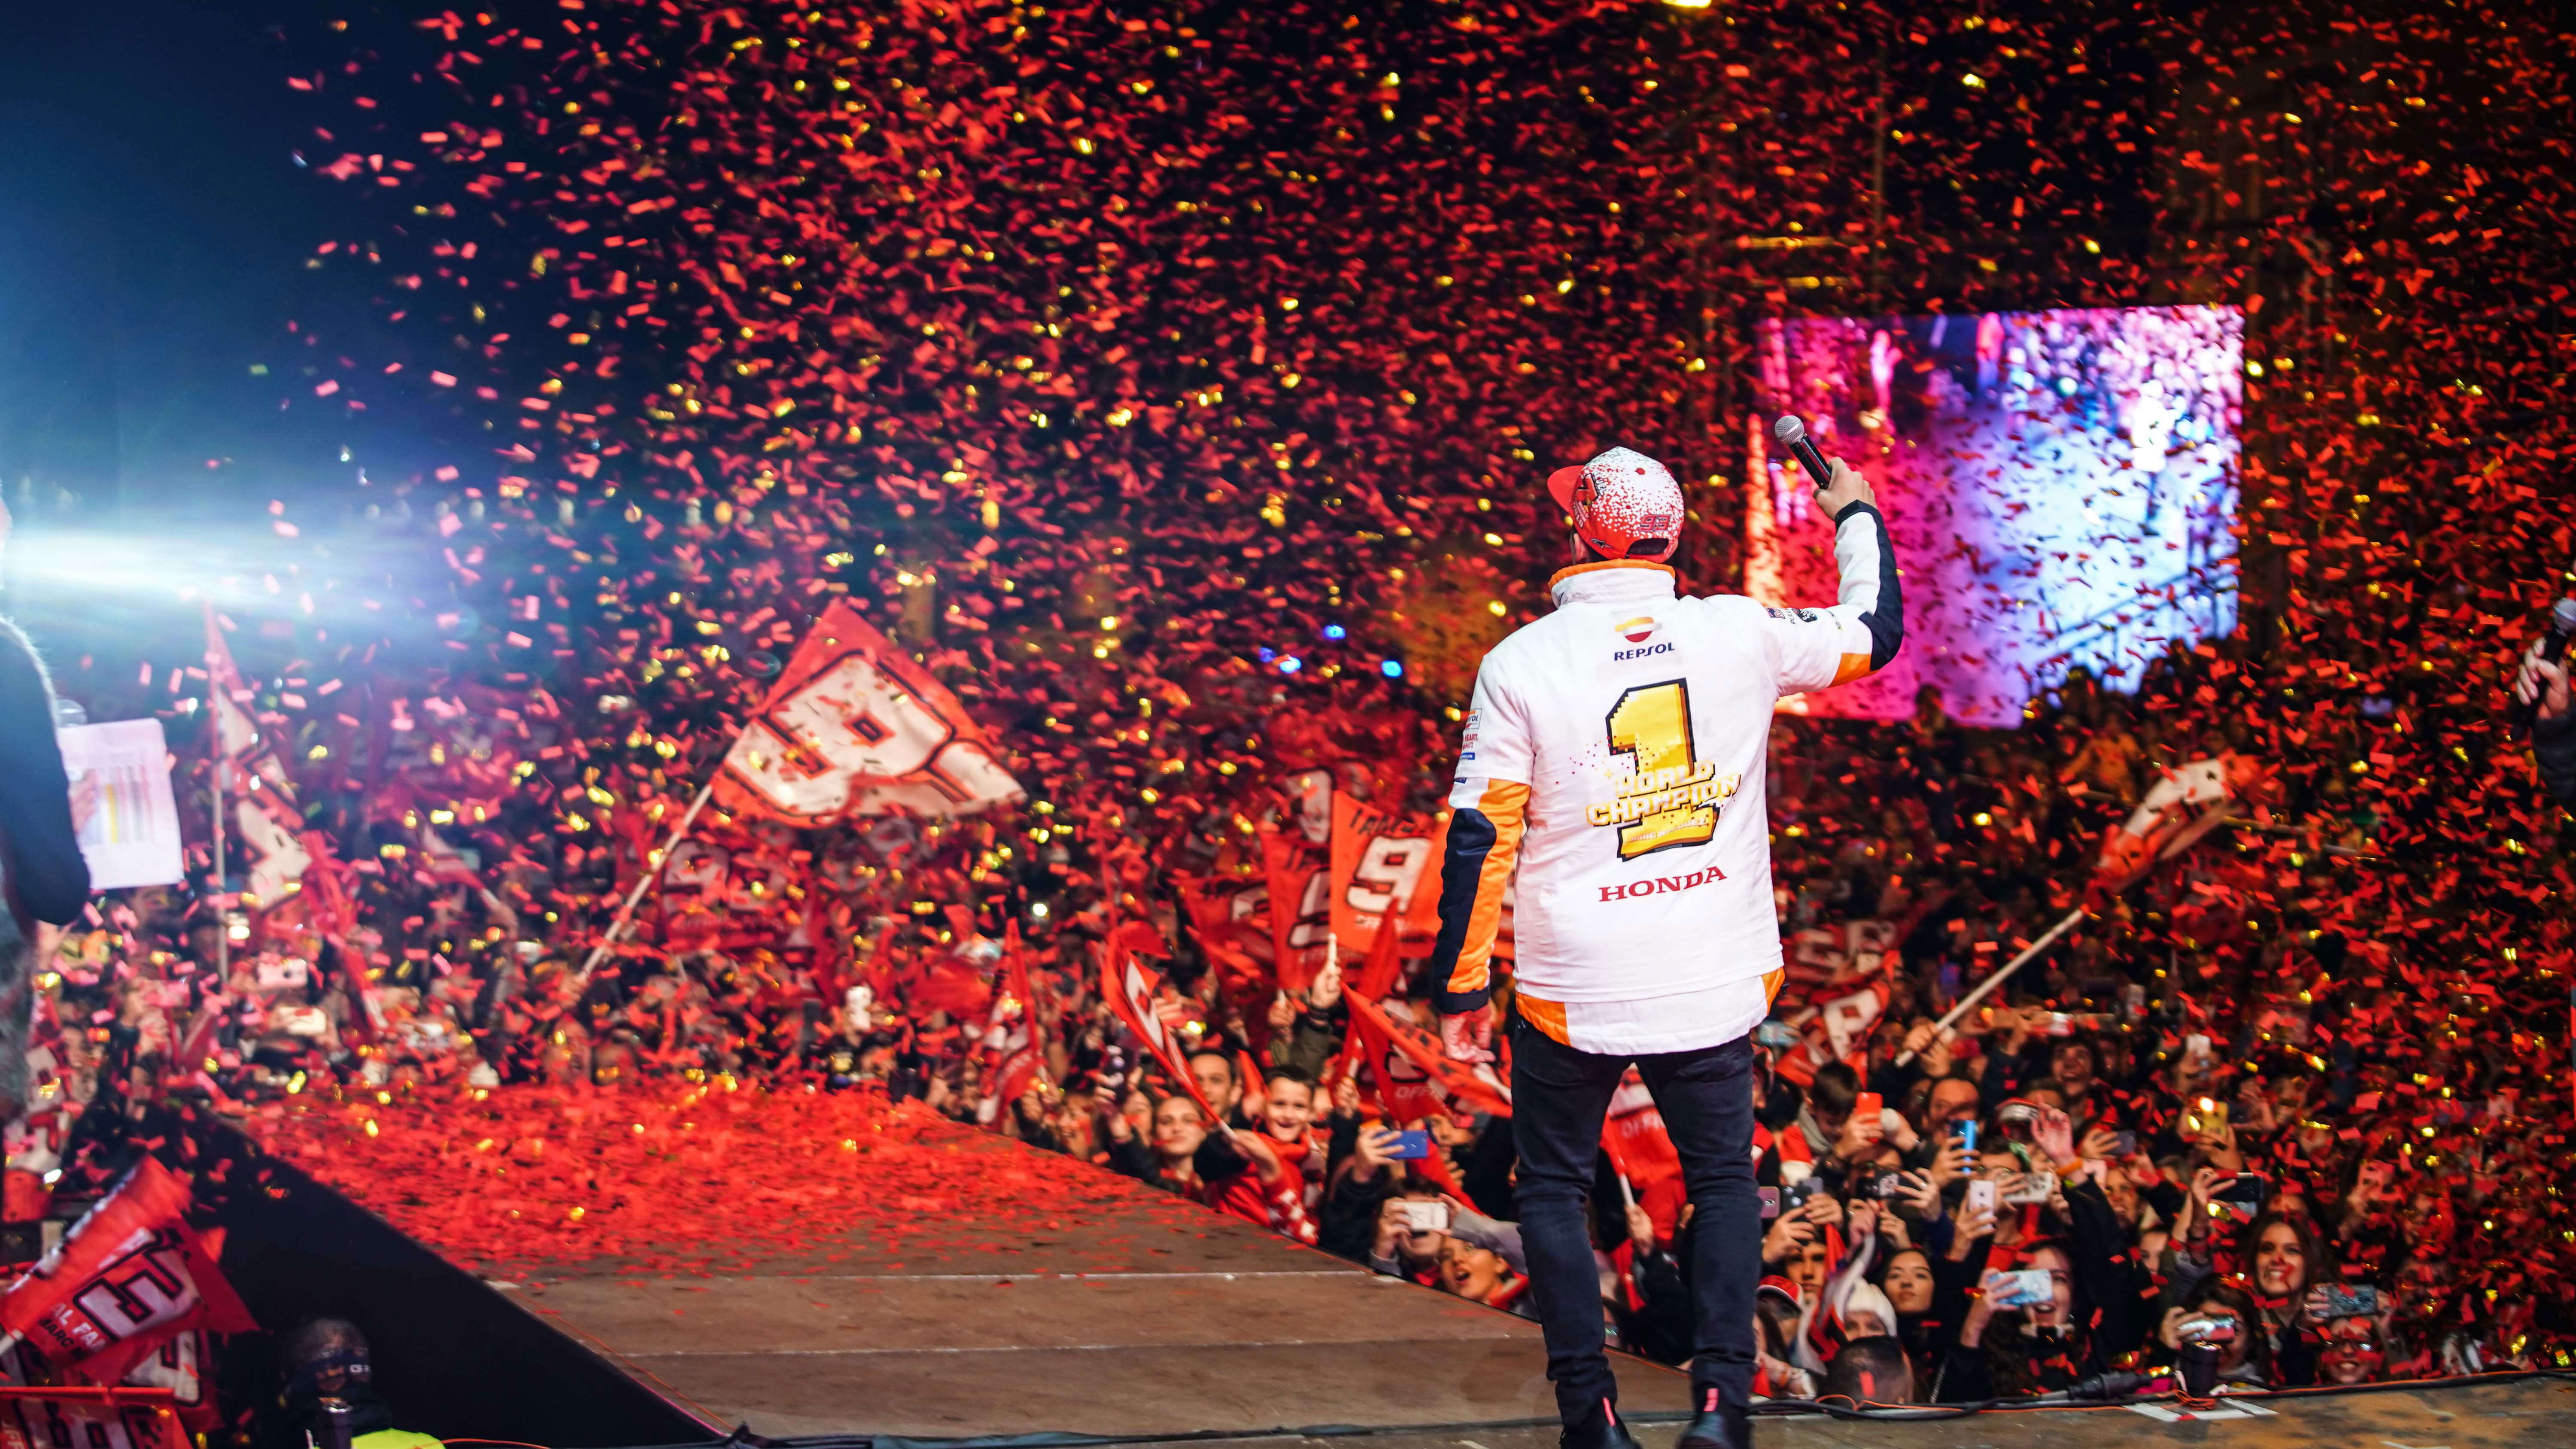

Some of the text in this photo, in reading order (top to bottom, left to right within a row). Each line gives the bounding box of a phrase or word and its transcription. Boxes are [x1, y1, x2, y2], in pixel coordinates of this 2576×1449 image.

[1614, 642, 1675, 661] REPSOL
[1605, 677, 1720, 862] 1
[1616, 761, 1716, 796] WORLD
[1586, 774, 1741, 826] CHAMPION
[1598, 866, 1727, 902] HONDA
